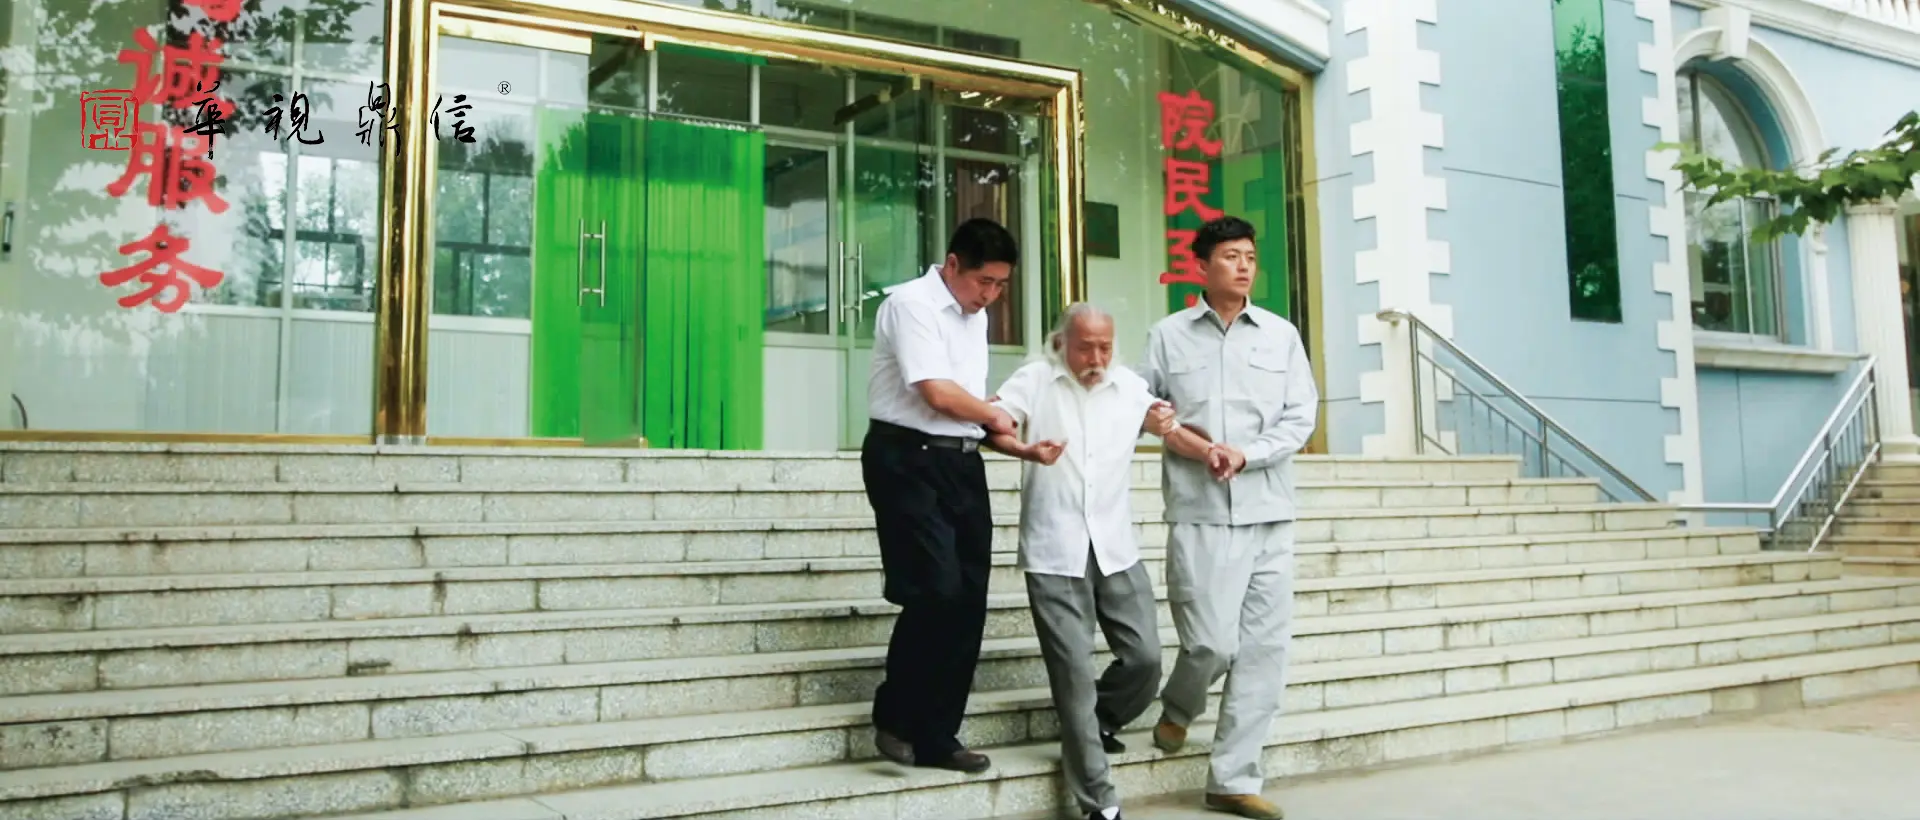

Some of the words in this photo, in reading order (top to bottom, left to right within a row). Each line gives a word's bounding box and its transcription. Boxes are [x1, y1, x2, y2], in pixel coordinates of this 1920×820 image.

[99, 0, 241, 313] 诚服务
[1156, 89, 1226, 307] 院民至
